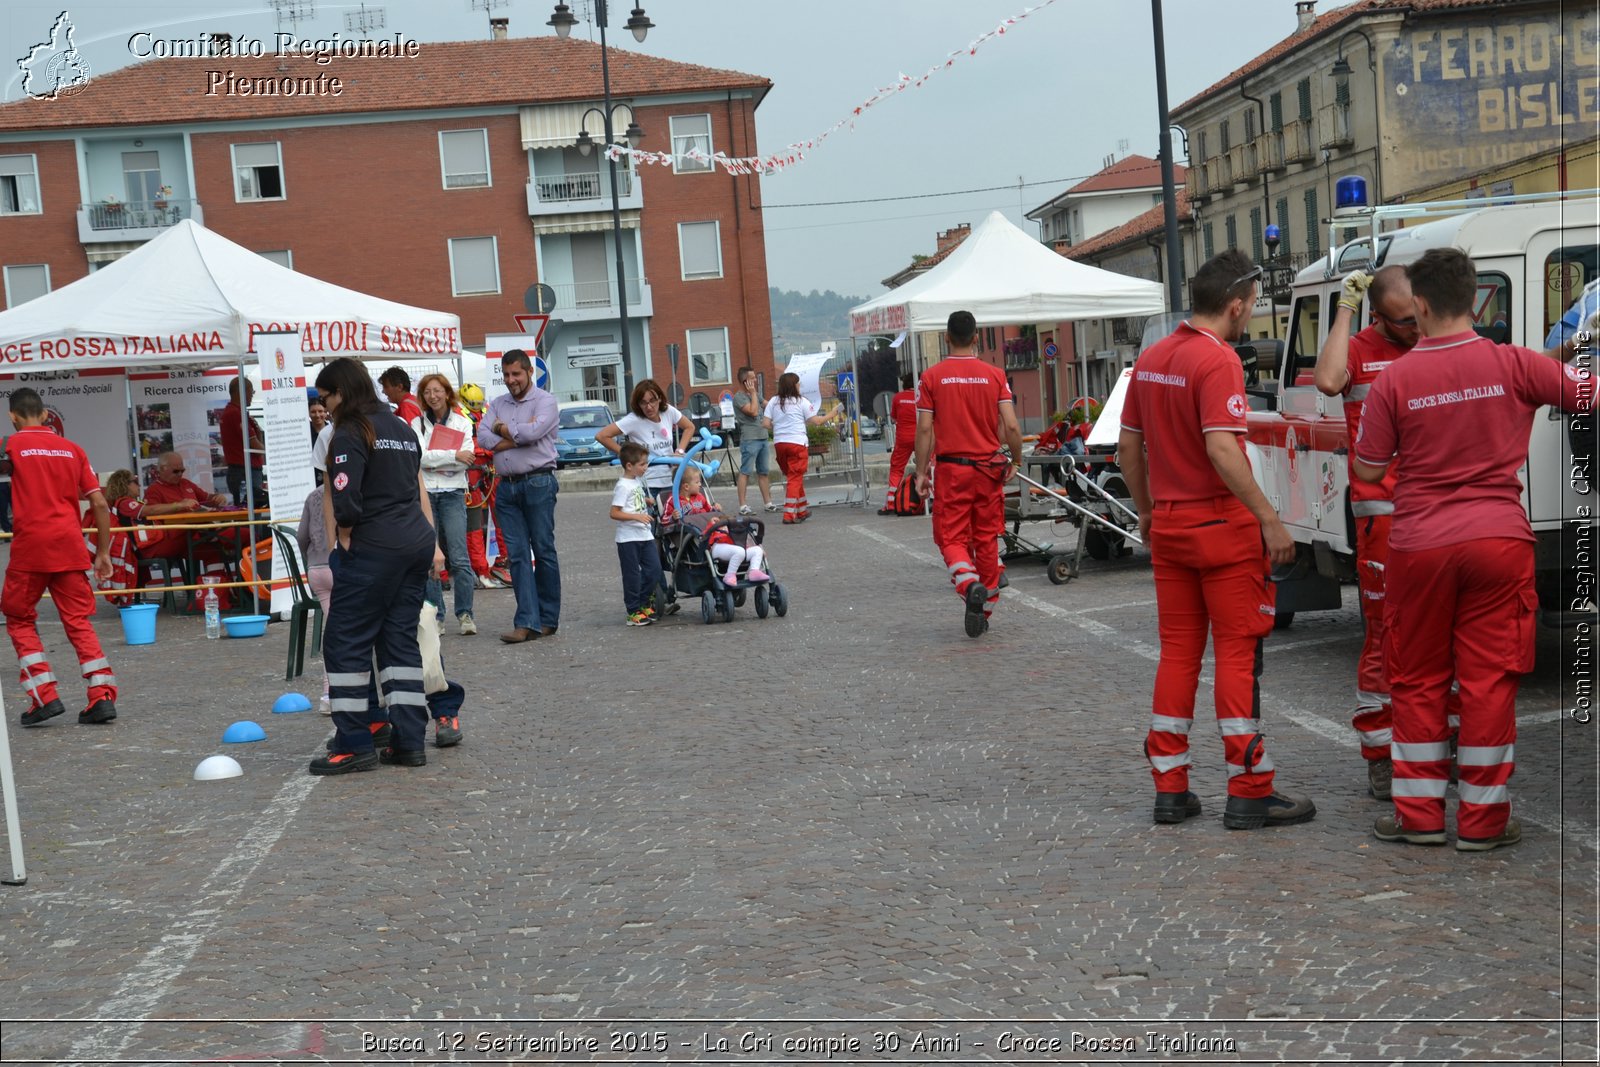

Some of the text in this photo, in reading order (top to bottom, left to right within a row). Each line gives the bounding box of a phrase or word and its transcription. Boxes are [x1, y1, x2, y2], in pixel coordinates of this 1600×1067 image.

[0, 331, 225, 364] CE ROSSA ITALIANA
[246, 320, 459, 354] DATORI SANGUE
[47, 385, 81, 397] Tecniche
[82, 383, 113, 396] Speciali
[144, 382, 227, 396] Ricerca dispersi
[1408, 384, 1505, 410] CROCE ROSSA ITALIANA
